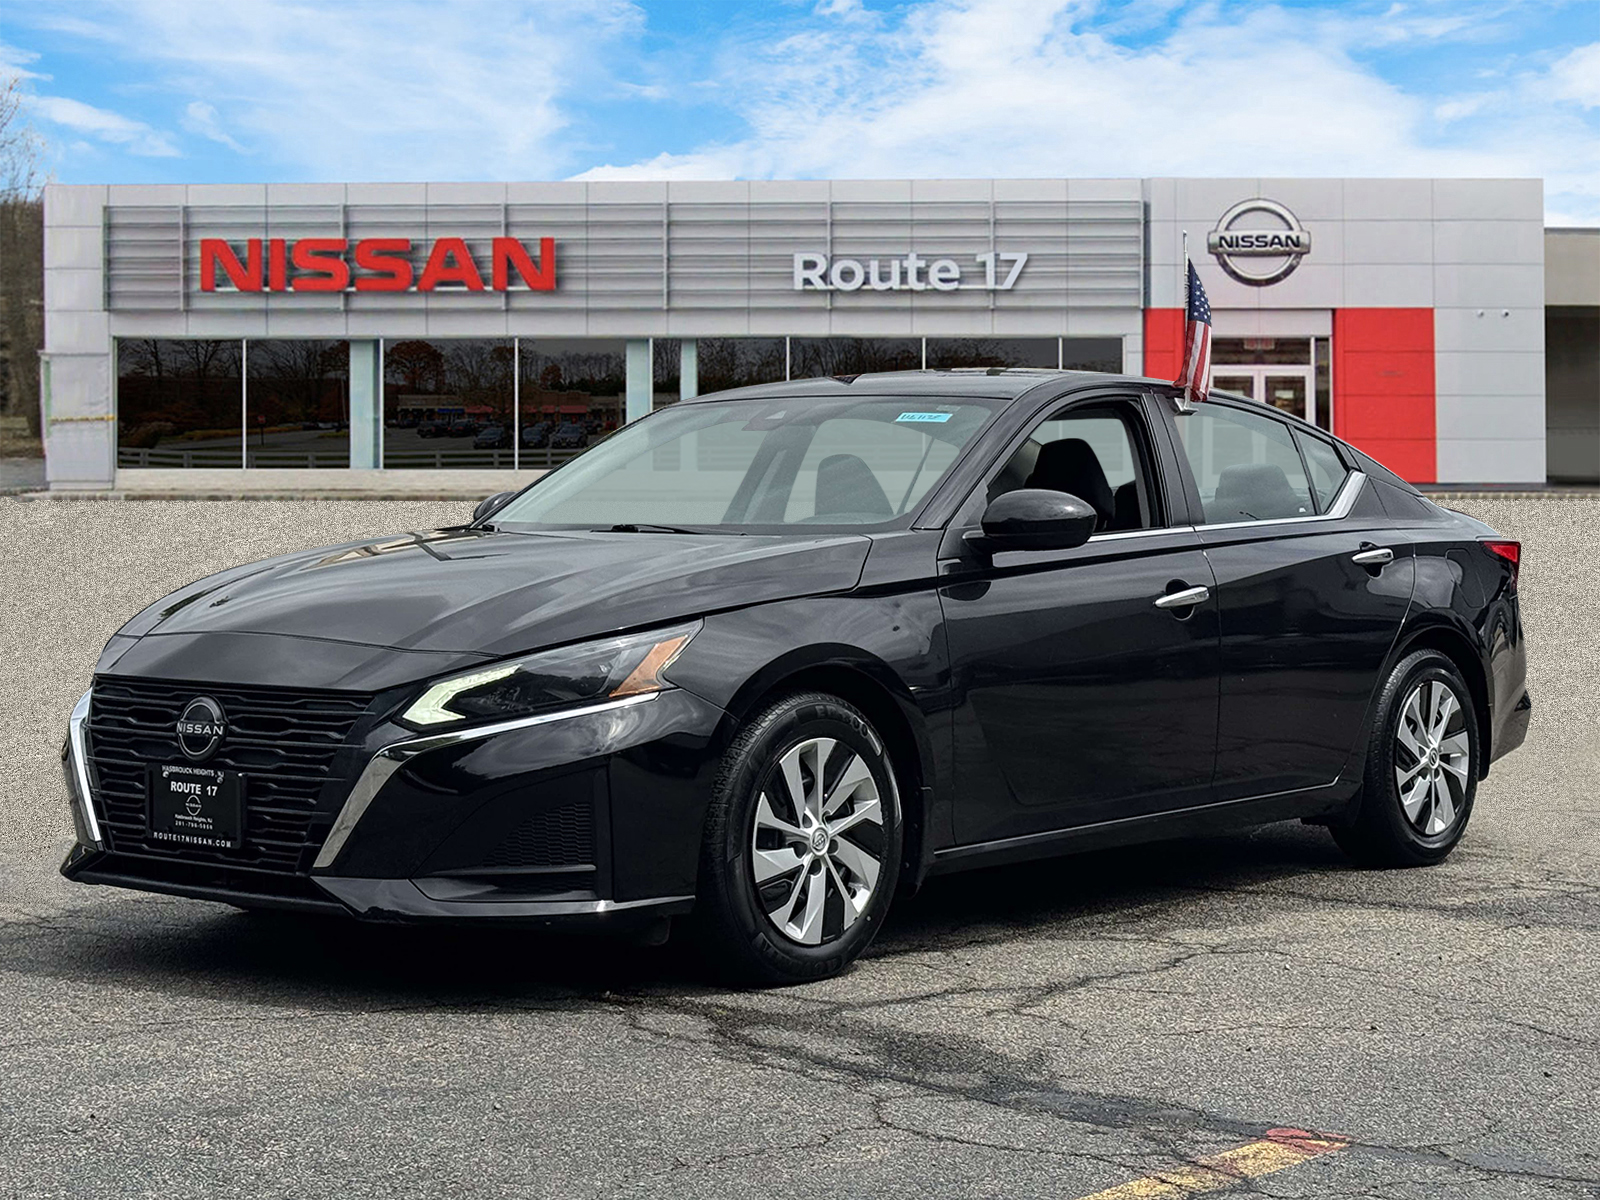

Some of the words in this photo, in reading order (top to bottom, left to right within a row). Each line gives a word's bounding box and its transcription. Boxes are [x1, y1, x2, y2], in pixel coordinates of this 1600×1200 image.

[1219, 235, 1300, 248] NISSAN
[200, 237, 555, 292] NISSAN
[793, 252, 961, 291] Route
[976, 252, 1028, 290] 17
[177, 722, 223, 735] NISSAN
[170, 781, 202, 795] ROUTE
[206, 786, 218, 796] 17
[153, 831, 232, 848] ROUTE17NISSAN.COM
